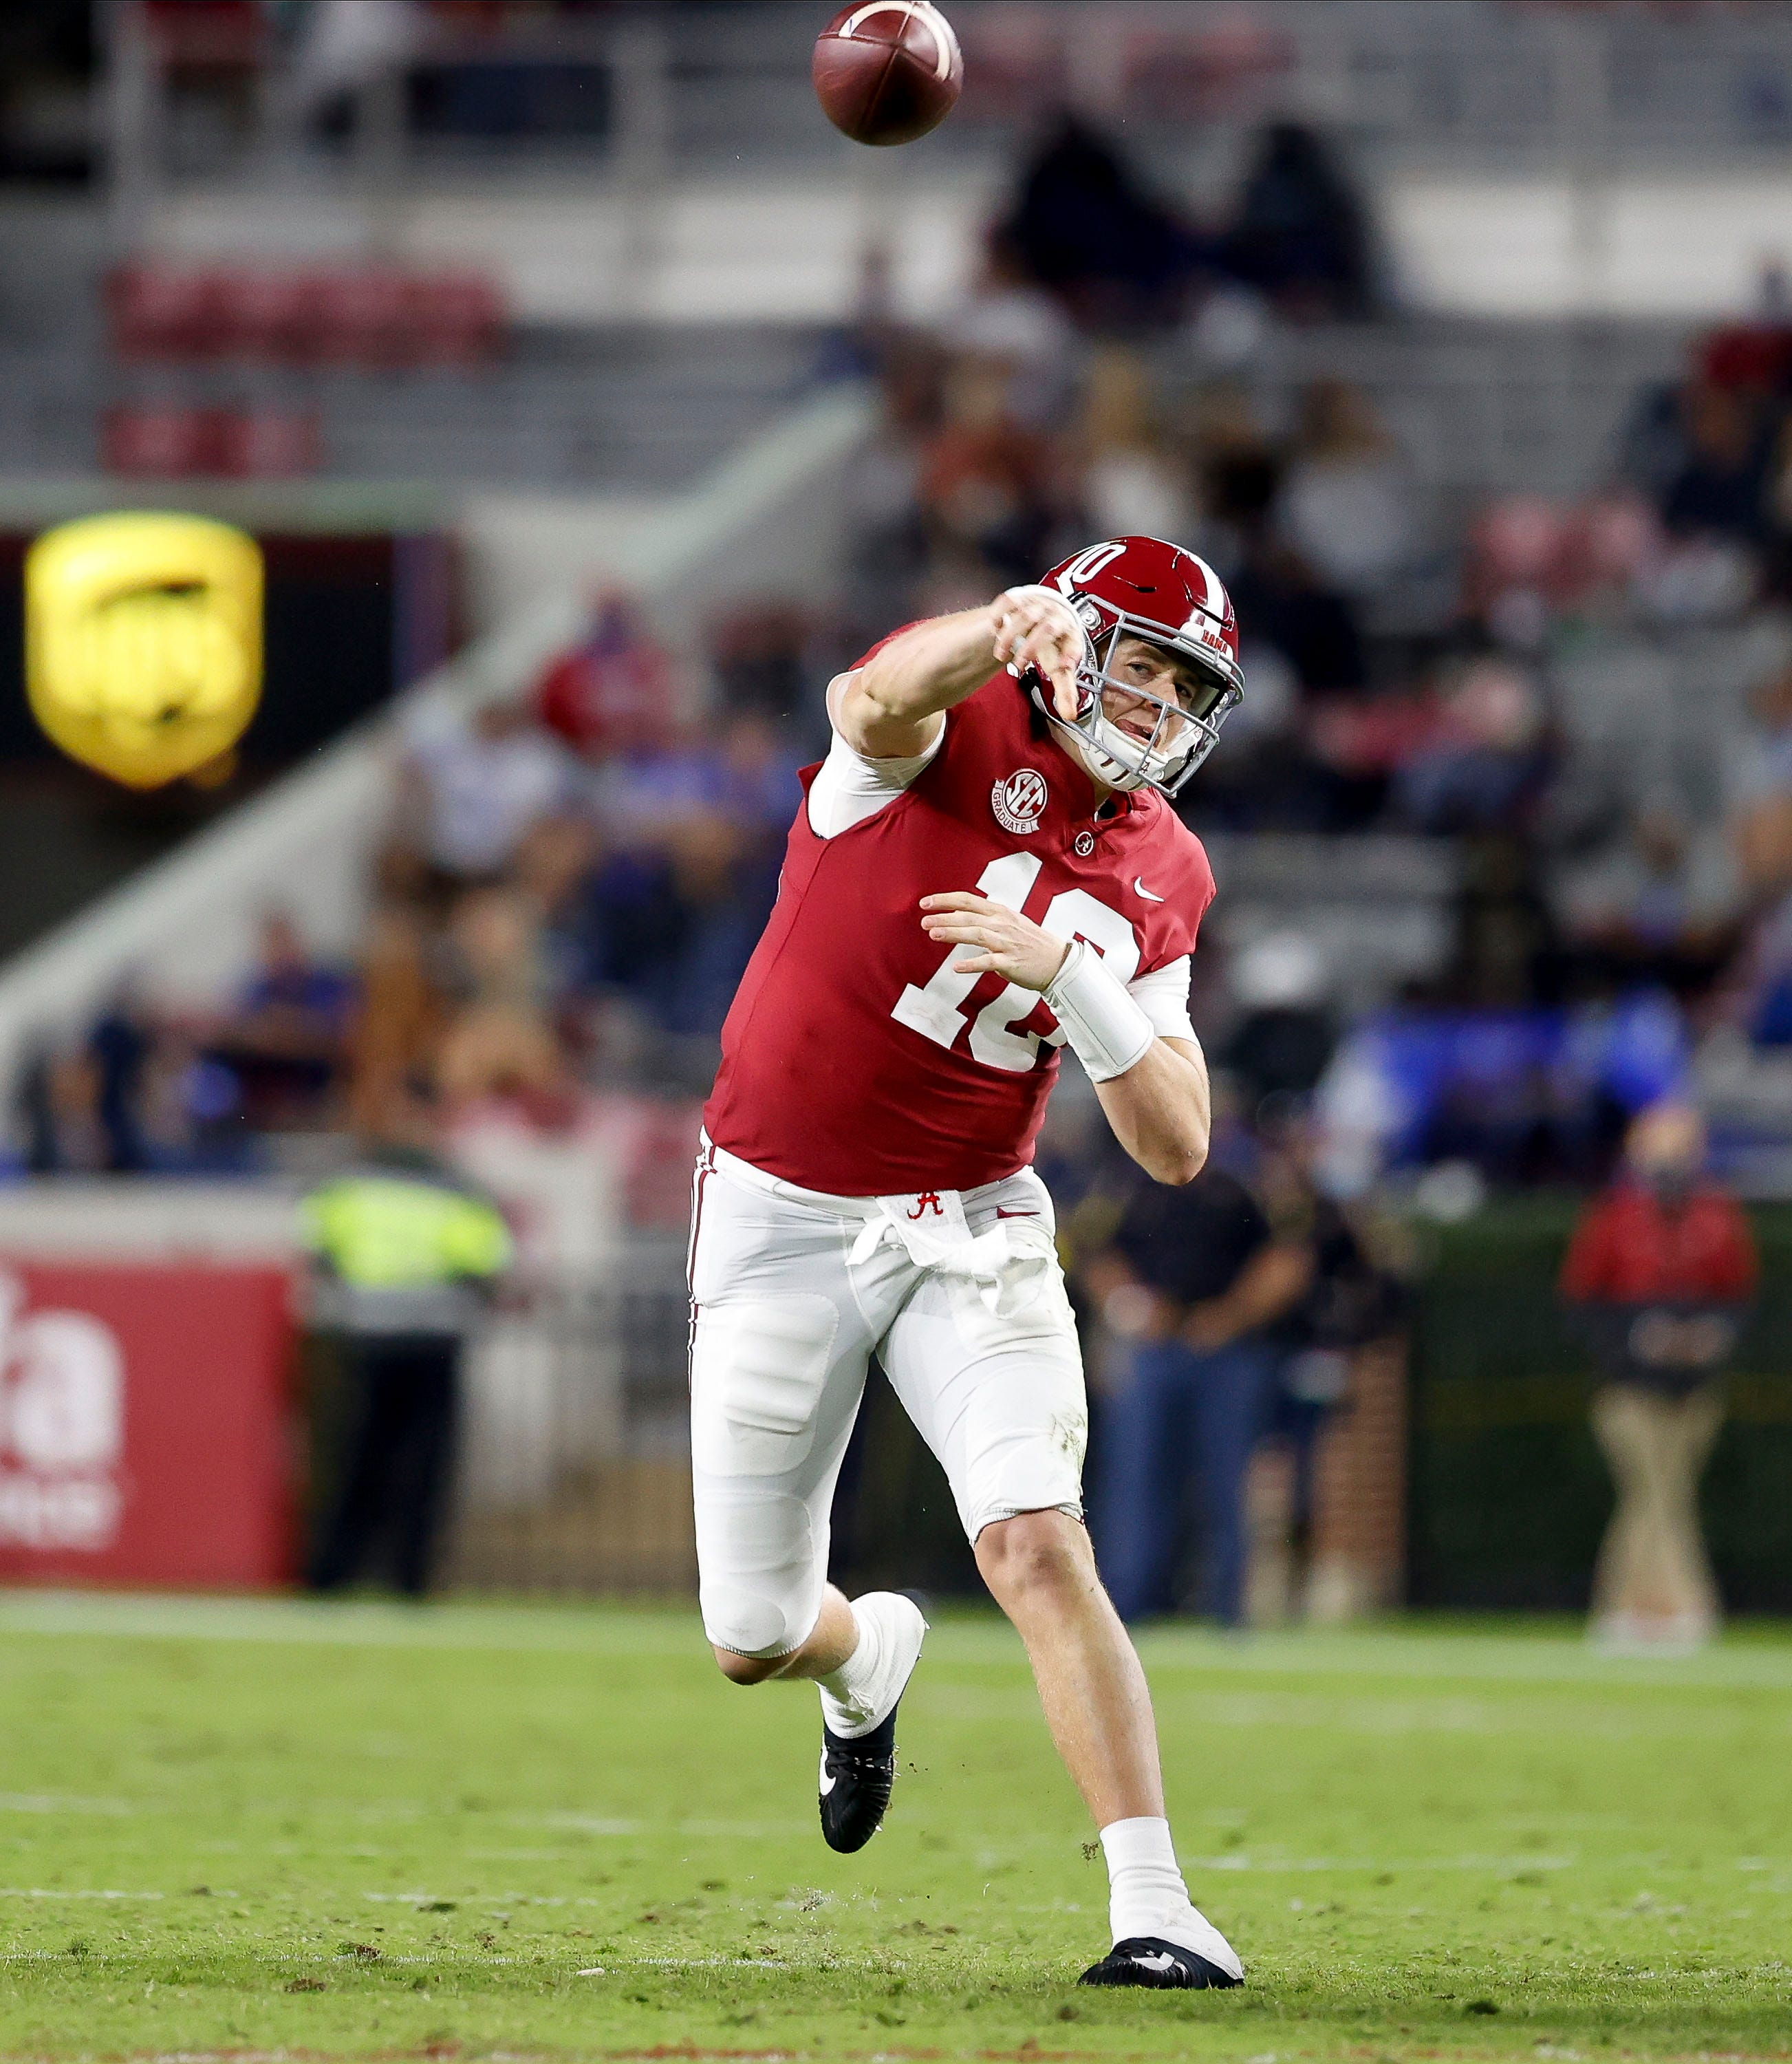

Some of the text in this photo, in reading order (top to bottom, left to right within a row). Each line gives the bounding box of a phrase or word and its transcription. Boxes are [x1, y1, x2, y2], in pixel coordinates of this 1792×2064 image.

[993, 792, 1027, 832] GRADUATE
[1006, 773, 1044, 817] SEC
[890, 850, 1141, 1073] 10
